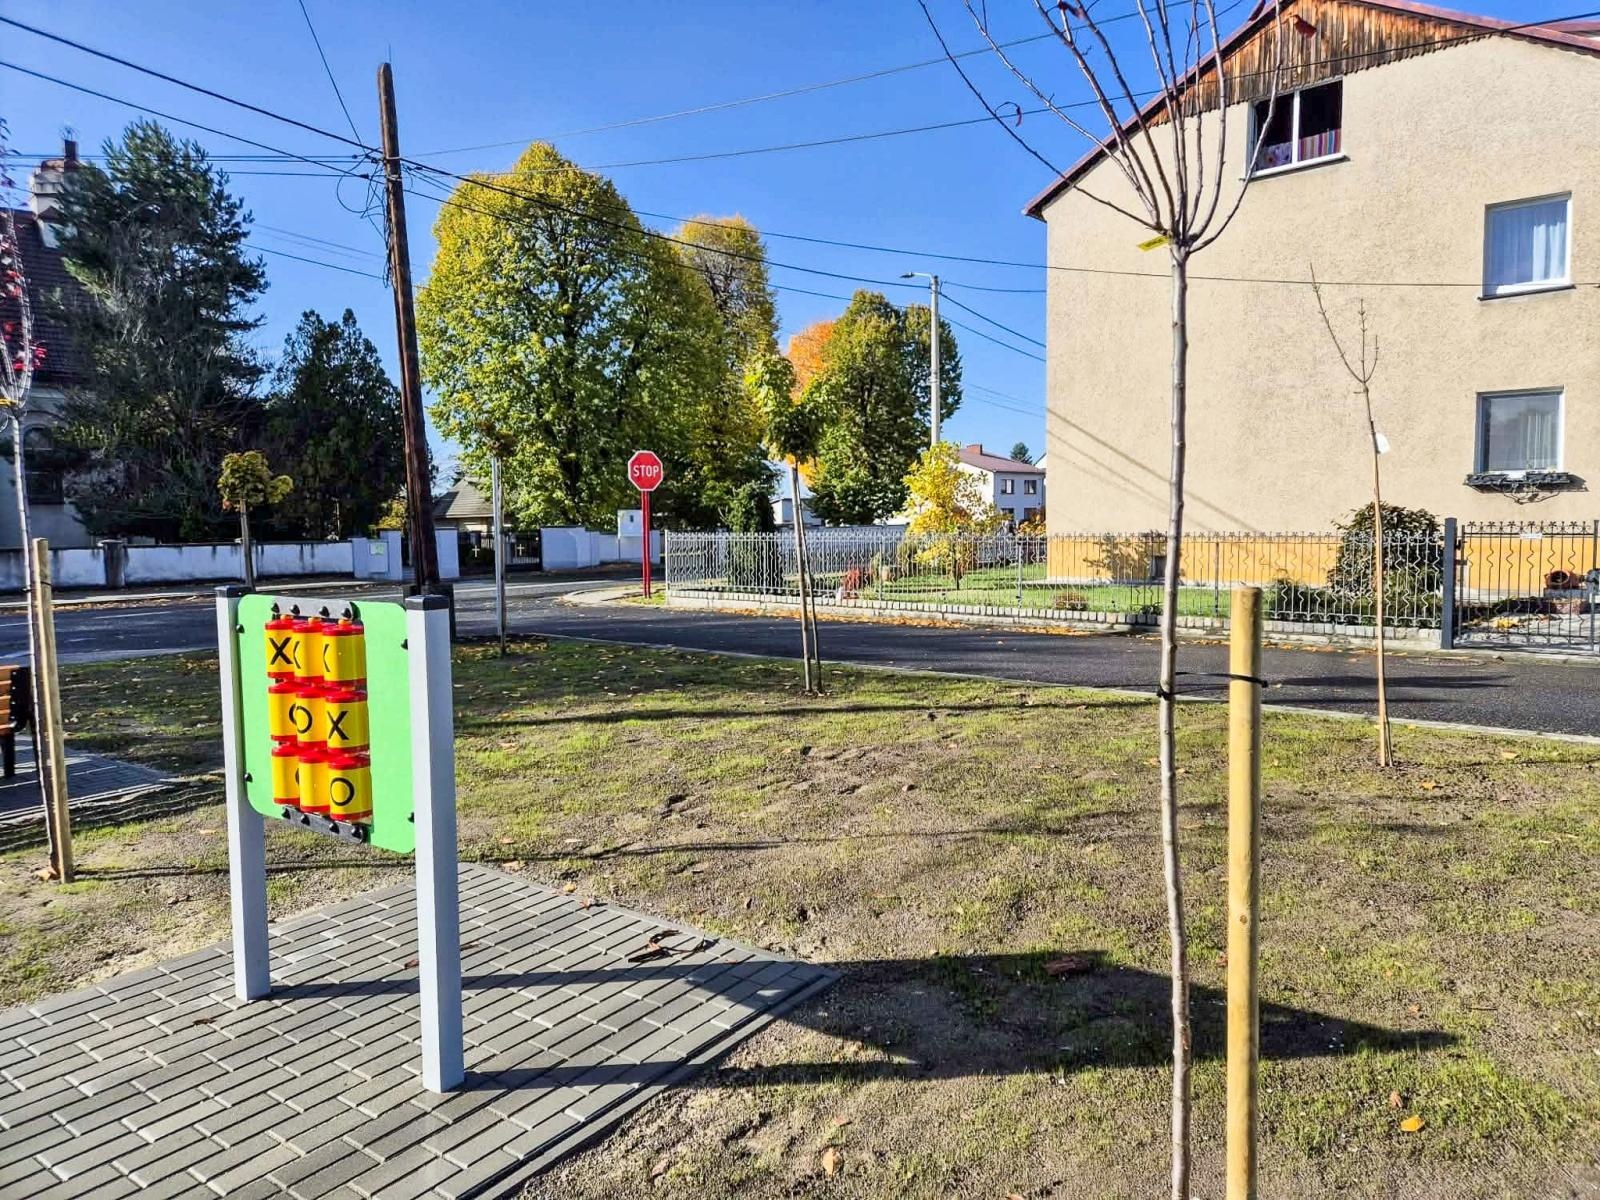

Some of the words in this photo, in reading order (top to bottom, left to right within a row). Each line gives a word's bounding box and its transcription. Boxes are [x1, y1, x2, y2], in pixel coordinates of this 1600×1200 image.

[633, 464, 660, 478] STOP
[269, 636, 294, 666] X
[327, 710, 350, 740] X
[329, 777, 355, 806] O
